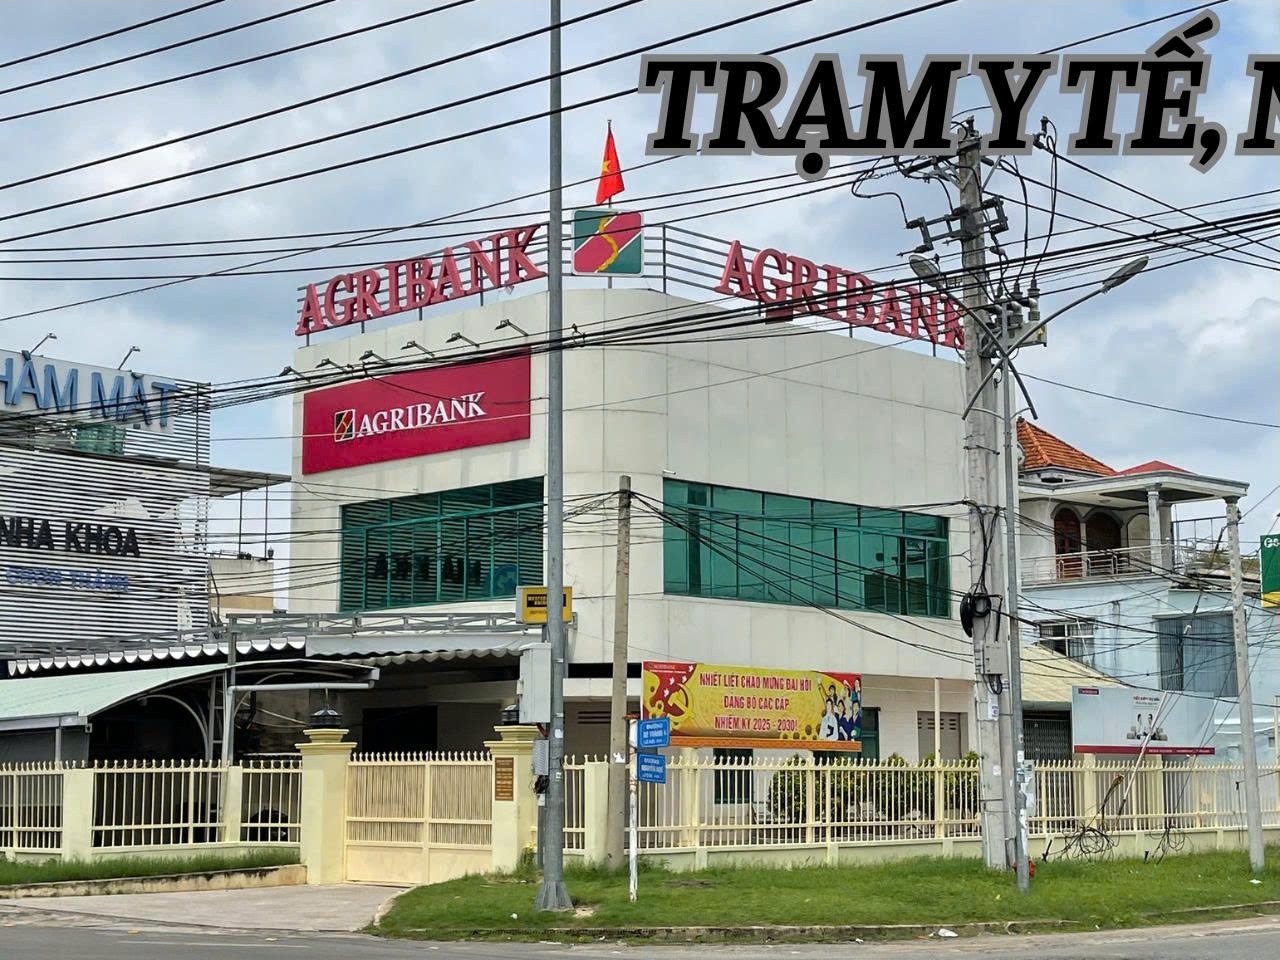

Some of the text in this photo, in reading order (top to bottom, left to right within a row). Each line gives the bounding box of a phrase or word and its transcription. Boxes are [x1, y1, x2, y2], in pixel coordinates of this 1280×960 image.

[295, 225, 548, 337] AGRIBANK
[714, 240, 965, 350] AGRIBANK
[356, 391, 488, 438] AGRIBANK
[0, 516, 140, 557] NHA KHOA
[753, 718, 771, 731] 2025
